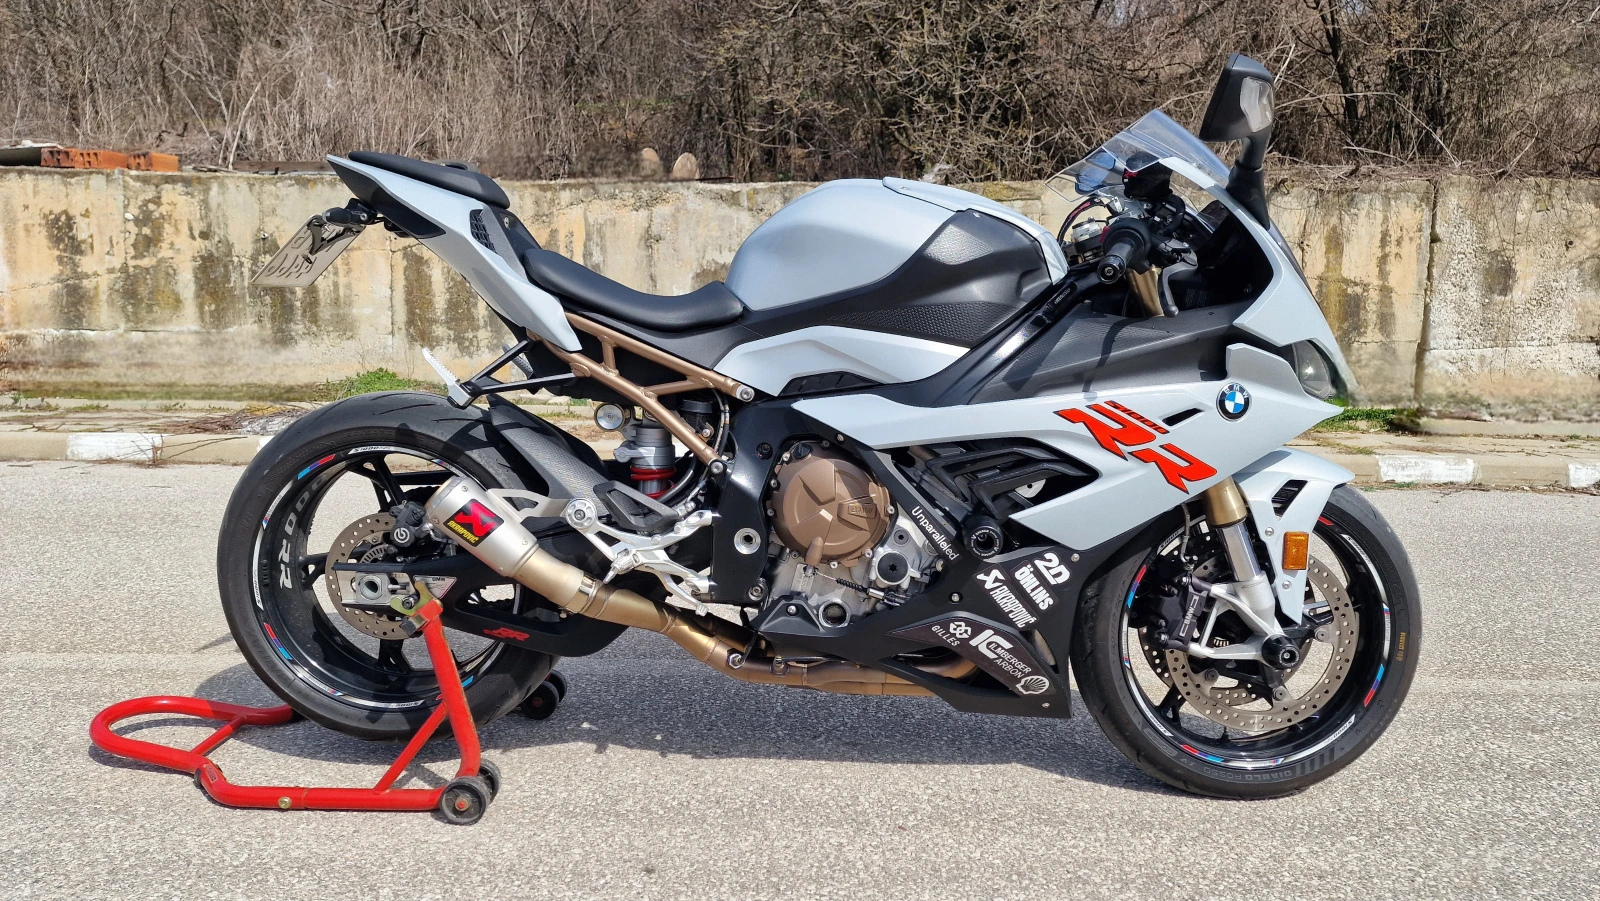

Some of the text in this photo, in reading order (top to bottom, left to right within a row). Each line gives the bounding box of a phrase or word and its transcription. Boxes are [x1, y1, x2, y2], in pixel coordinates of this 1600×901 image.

[1224, 384, 1249, 399] BMW
[911, 506, 960, 561] Unparalleled
[1034, 552, 1070, 585] 2D
[1014, 564, 1054, 610] ÖHLINS
[1184, 606, 1195, 625] BMW
[931, 625, 960, 647] GILLES
[988, 642, 1032, 674] ILMBERGER
[1244, 769, 1293, 781] DIABLO
